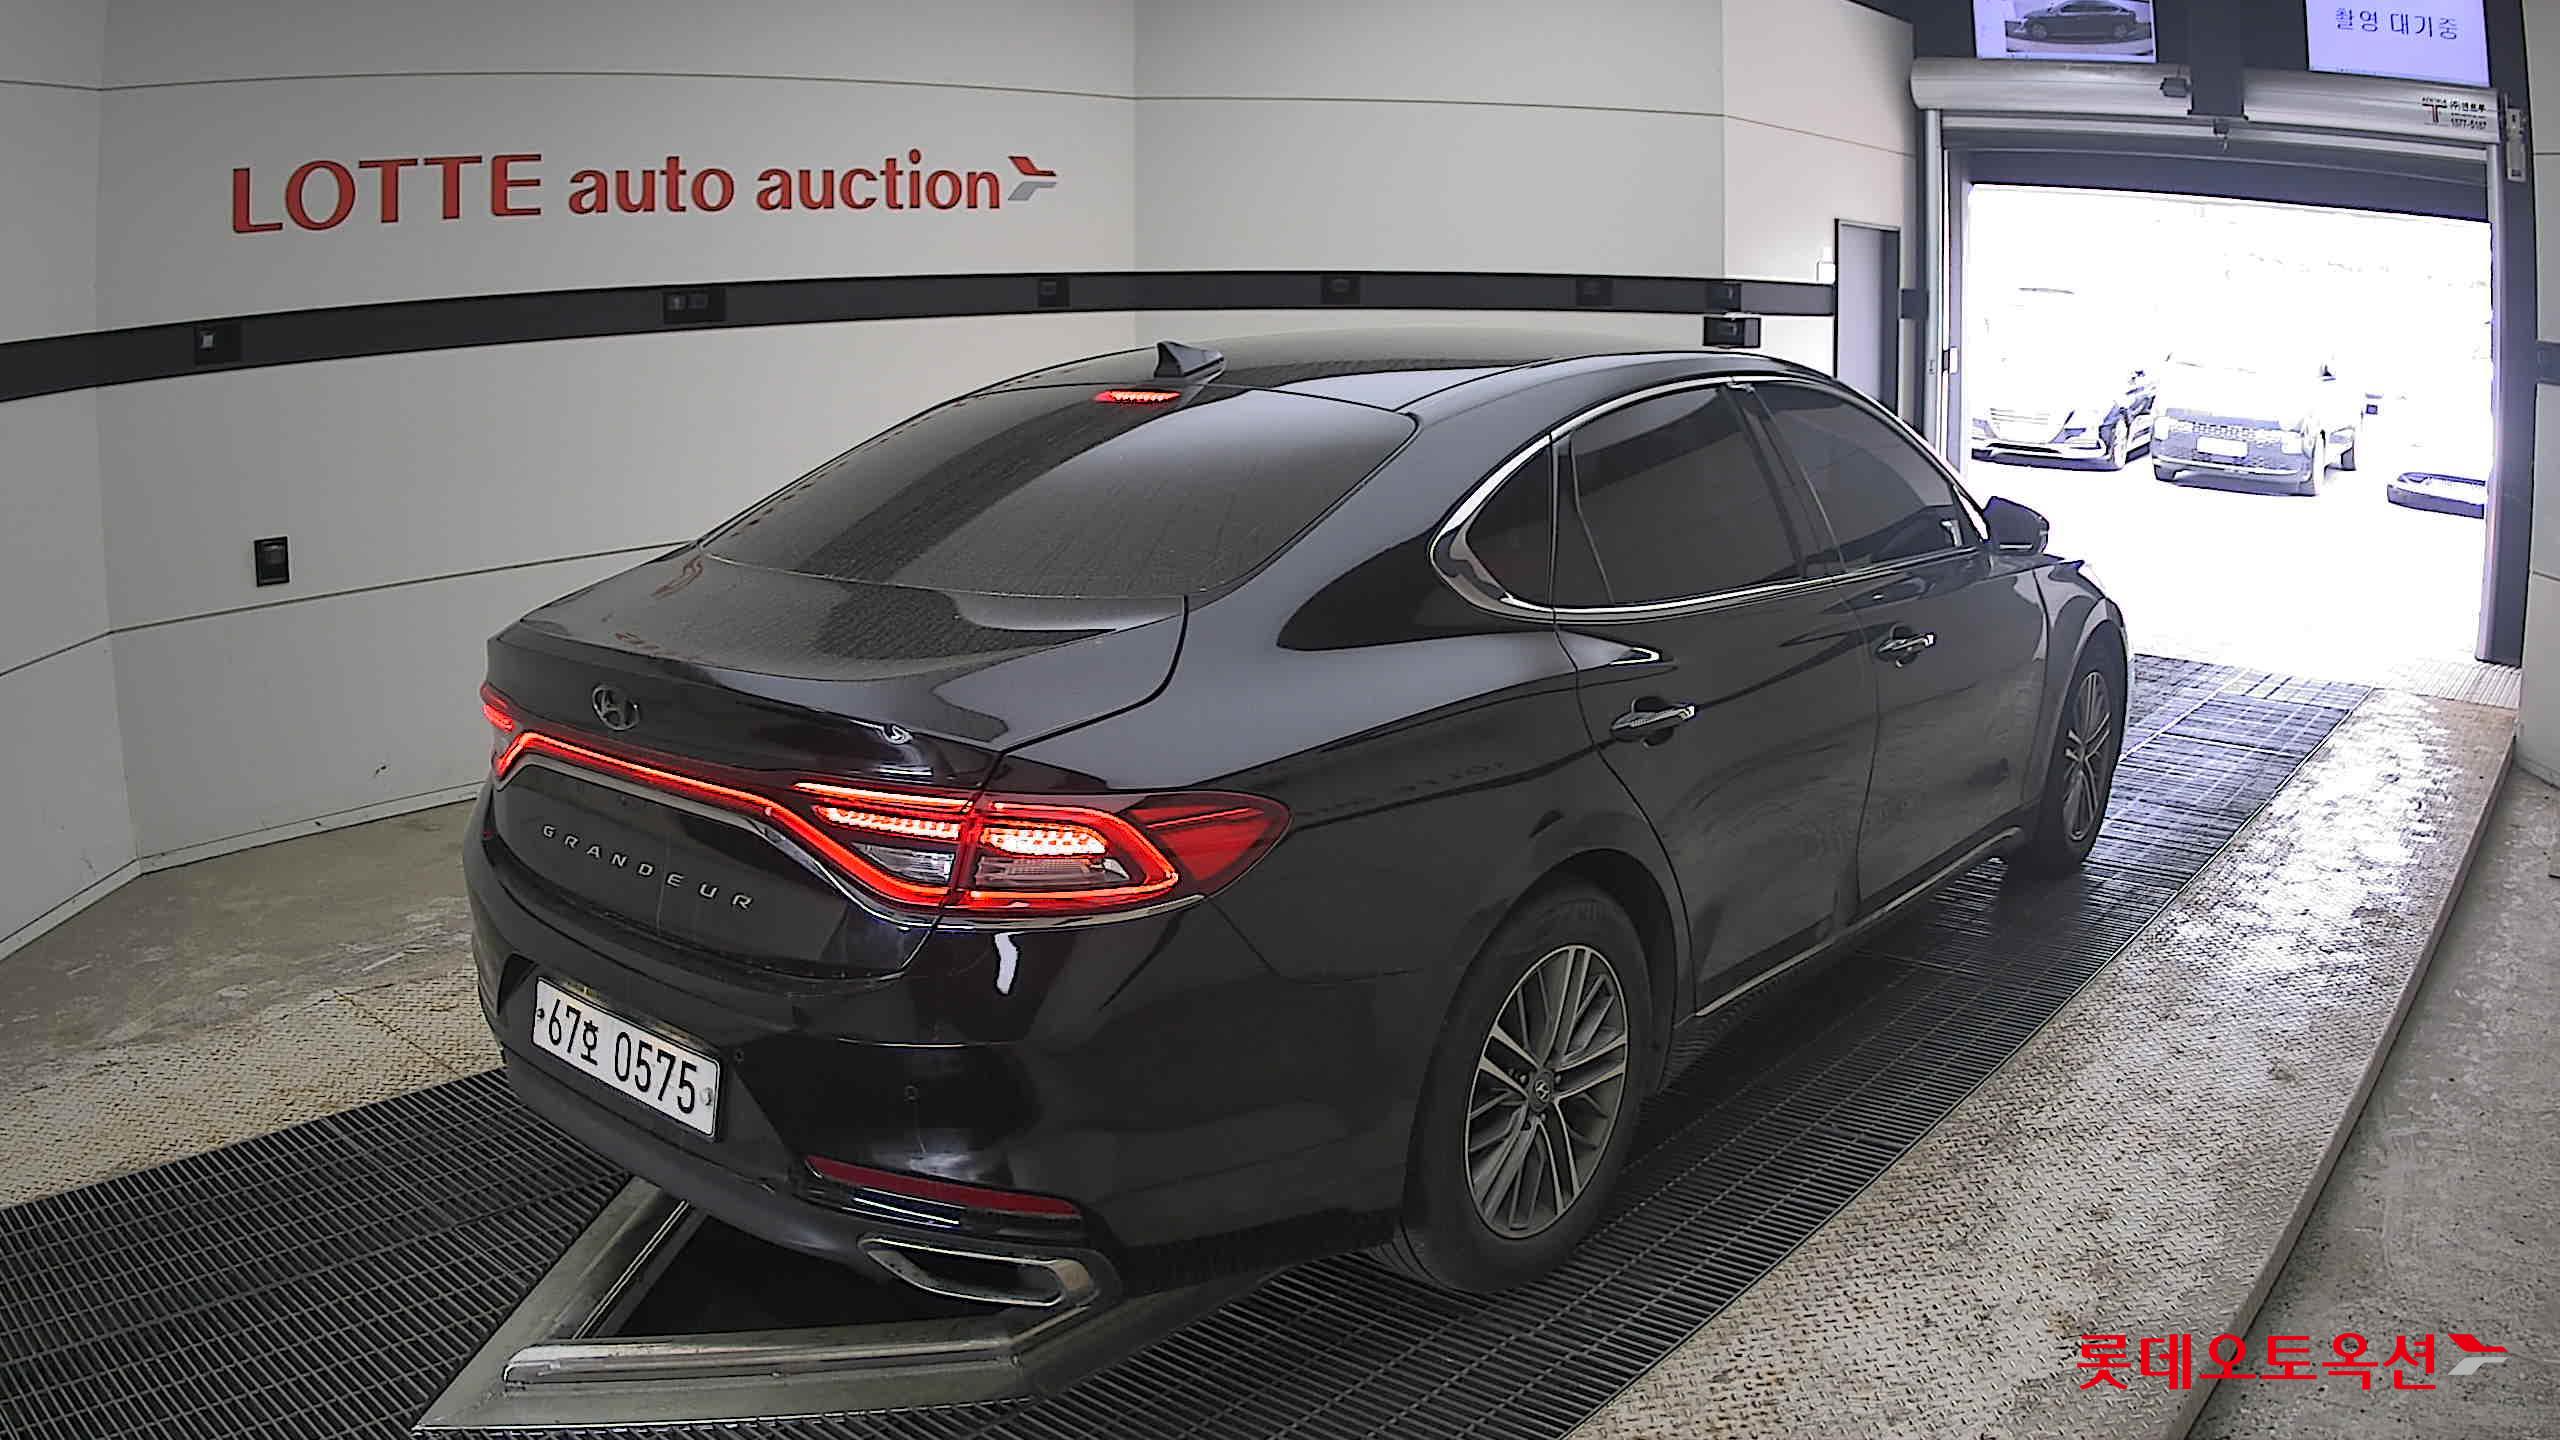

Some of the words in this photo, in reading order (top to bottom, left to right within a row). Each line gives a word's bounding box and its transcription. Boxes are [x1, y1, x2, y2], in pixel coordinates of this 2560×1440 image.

[2335, 8, 2378, 33] 촬영
[2390, 13, 2458, 41] 대기중
[231, 153, 543, 235] LOTTE
[567, 155, 735, 215] auto
[754, 148, 1002, 212] auction
[542, 824, 753, 909] GRANDEUR
[548, 998, 599, 1066] 67호
[614, 1031, 697, 1114] 0575
